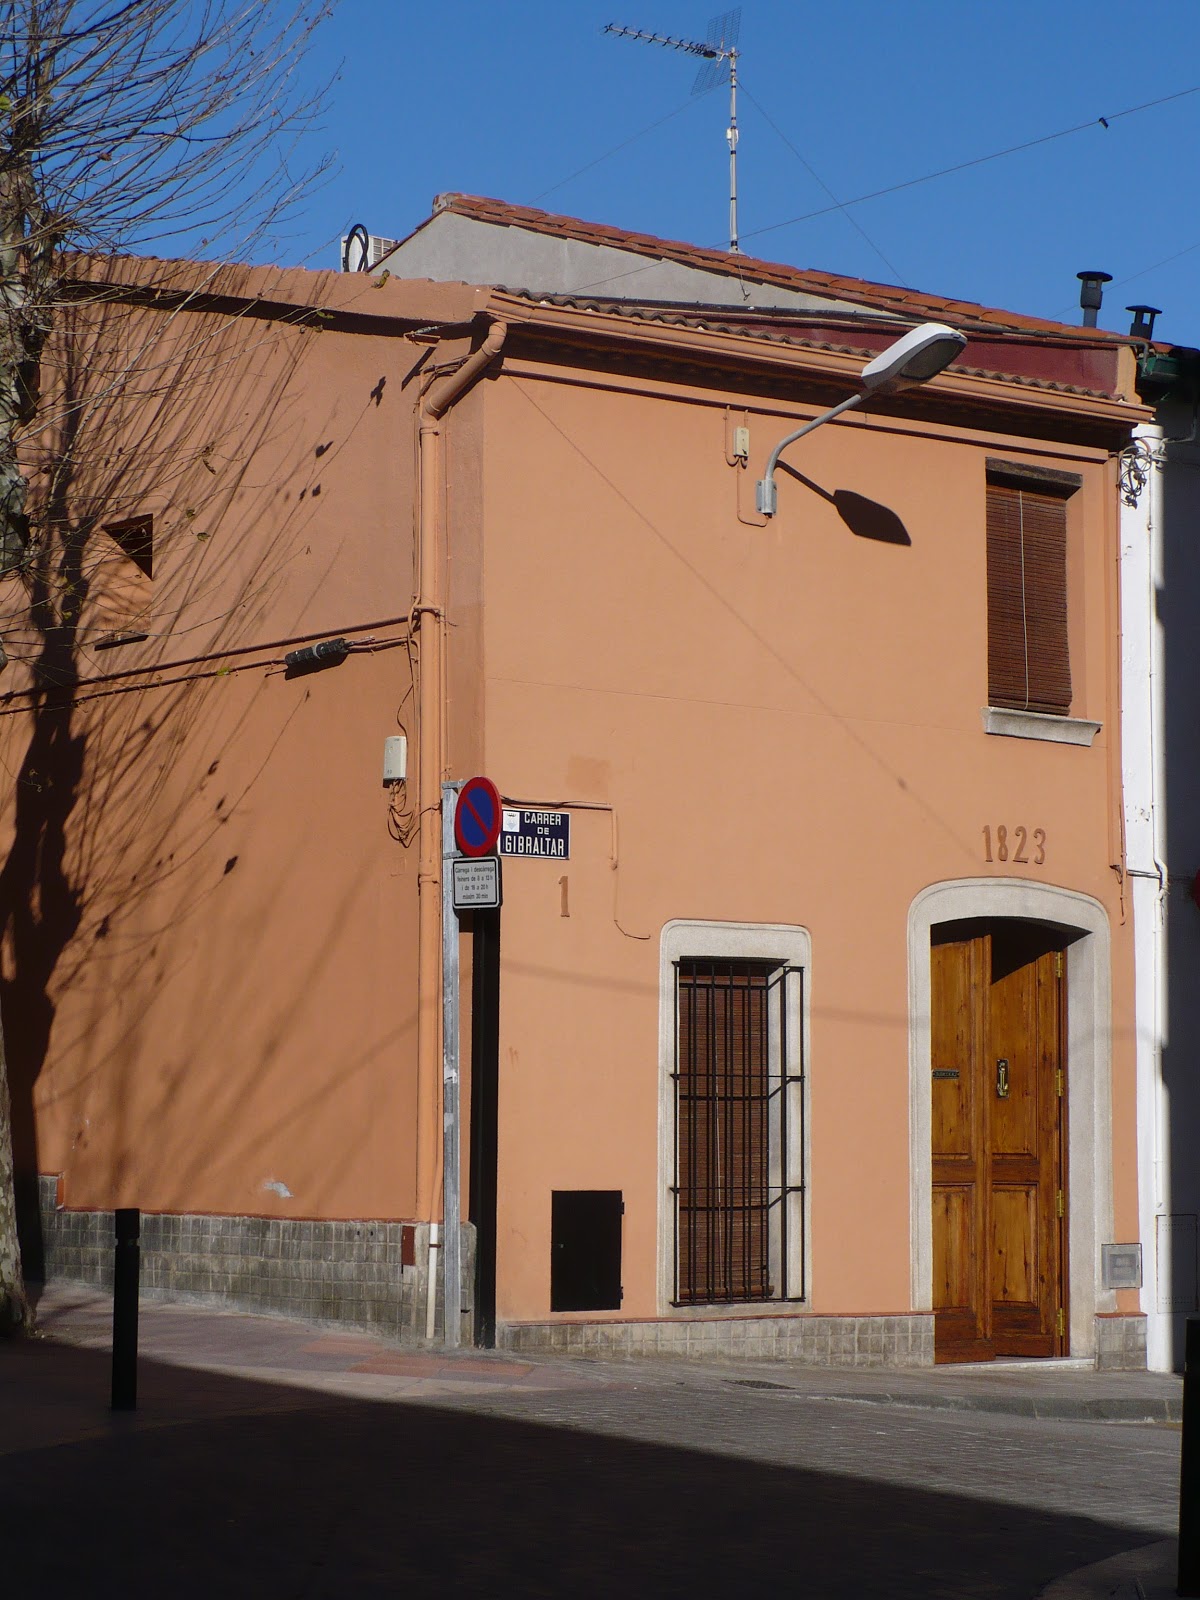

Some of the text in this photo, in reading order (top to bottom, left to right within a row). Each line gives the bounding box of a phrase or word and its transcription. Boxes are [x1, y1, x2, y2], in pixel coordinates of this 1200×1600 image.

[524, 811, 562, 826] CARRER
[537, 827, 550, 835] DE
[505, 835, 564, 856] GIBRALTAR
[982, 824, 1046, 865] 1823
[558, 875, 570, 917] 1
